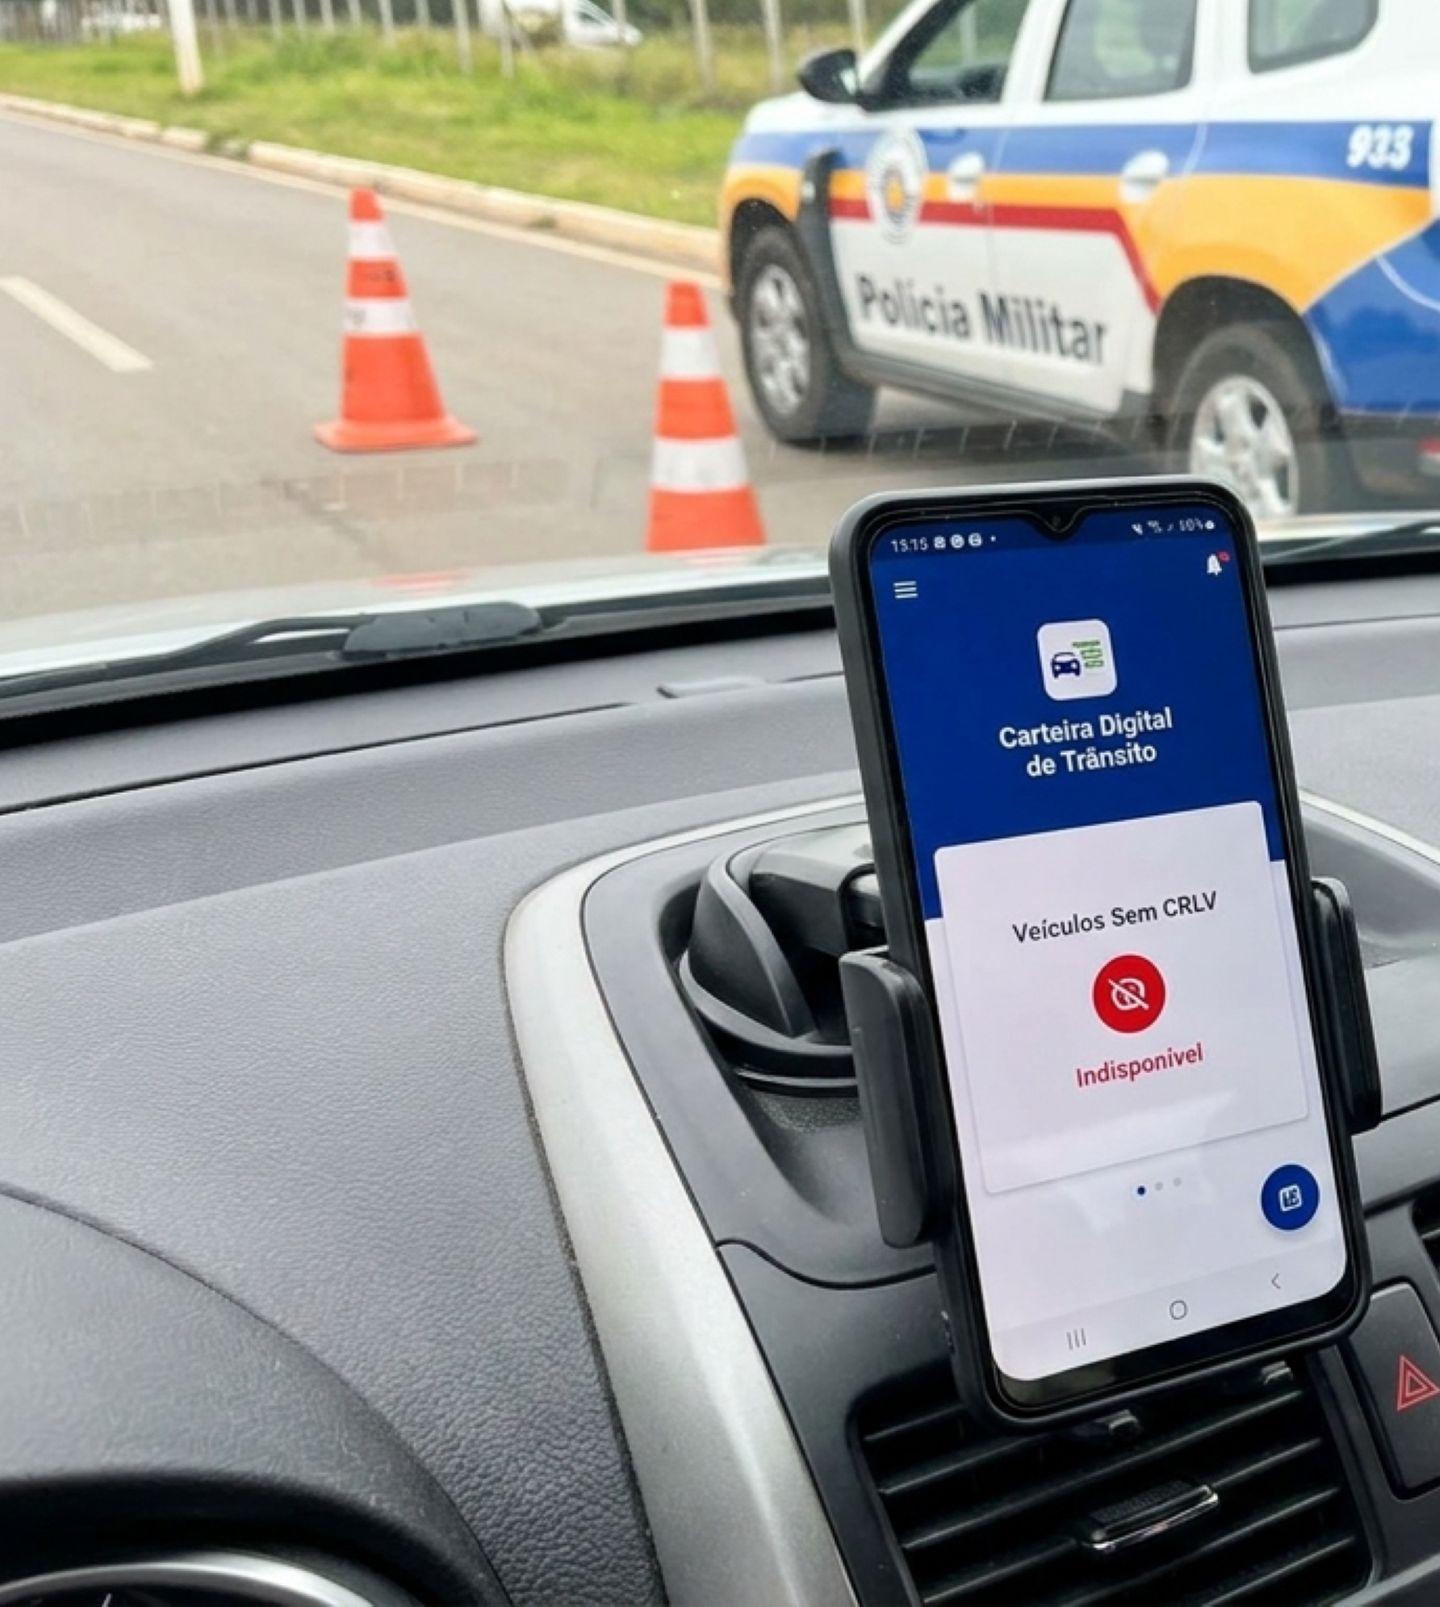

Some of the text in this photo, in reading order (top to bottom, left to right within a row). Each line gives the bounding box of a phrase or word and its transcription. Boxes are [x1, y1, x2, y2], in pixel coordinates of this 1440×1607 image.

[1346, 125, 1414, 170] 933
[857, 274, 1107, 365] Polícia Militar
[999, 706, 1173, 748] Carteira Digital
[1026, 741, 1157, 777] de Trânsito
[1110, 906, 1158, 927] Sem
[1162, 890, 1217, 917] CRLV
